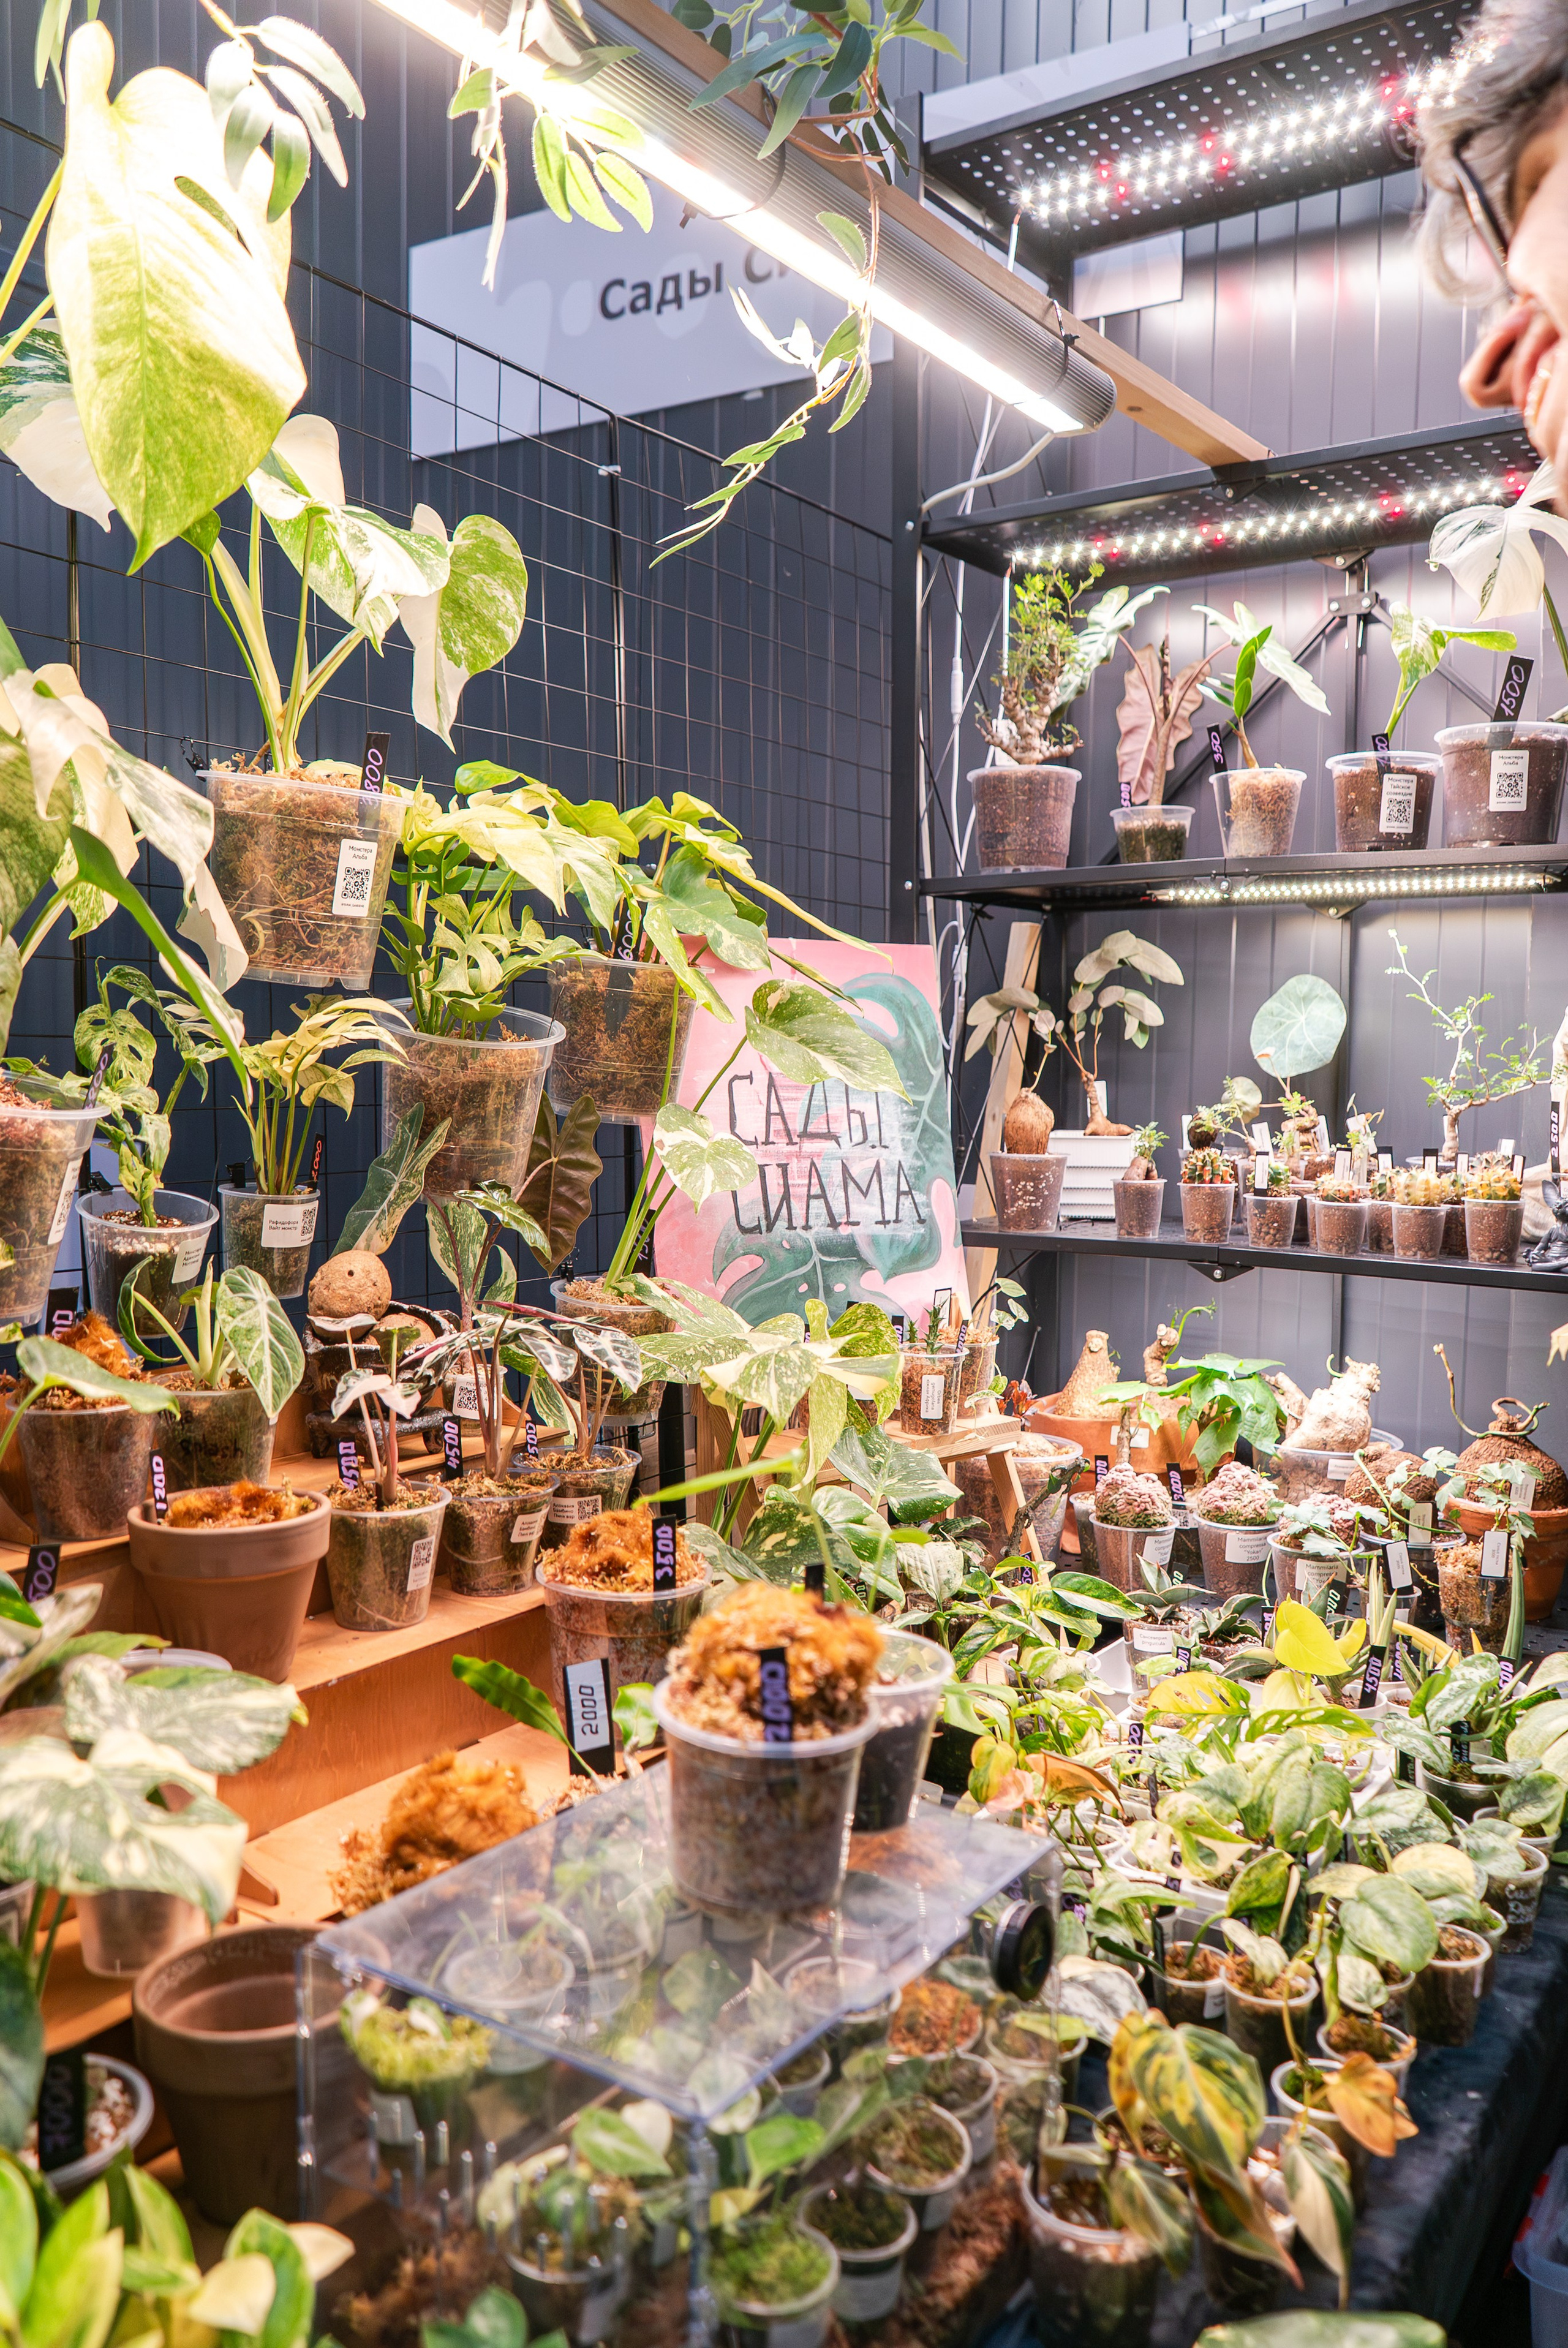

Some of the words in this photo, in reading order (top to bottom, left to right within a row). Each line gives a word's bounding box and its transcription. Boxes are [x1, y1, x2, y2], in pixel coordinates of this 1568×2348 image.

[600, 262, 723, 320] Сады
[1501, 665, 1525, 717] 1500
[1211, 731, 1224, 764] 350
[444, 1420, 461, 1469] 4500
[152, 1455, 167, 1511] 1200
[655, 1525, 674, 1580] 3500
[1363, 1656, 1383, 1694] 4500
[578, 1685, 599, 1736] 2000
